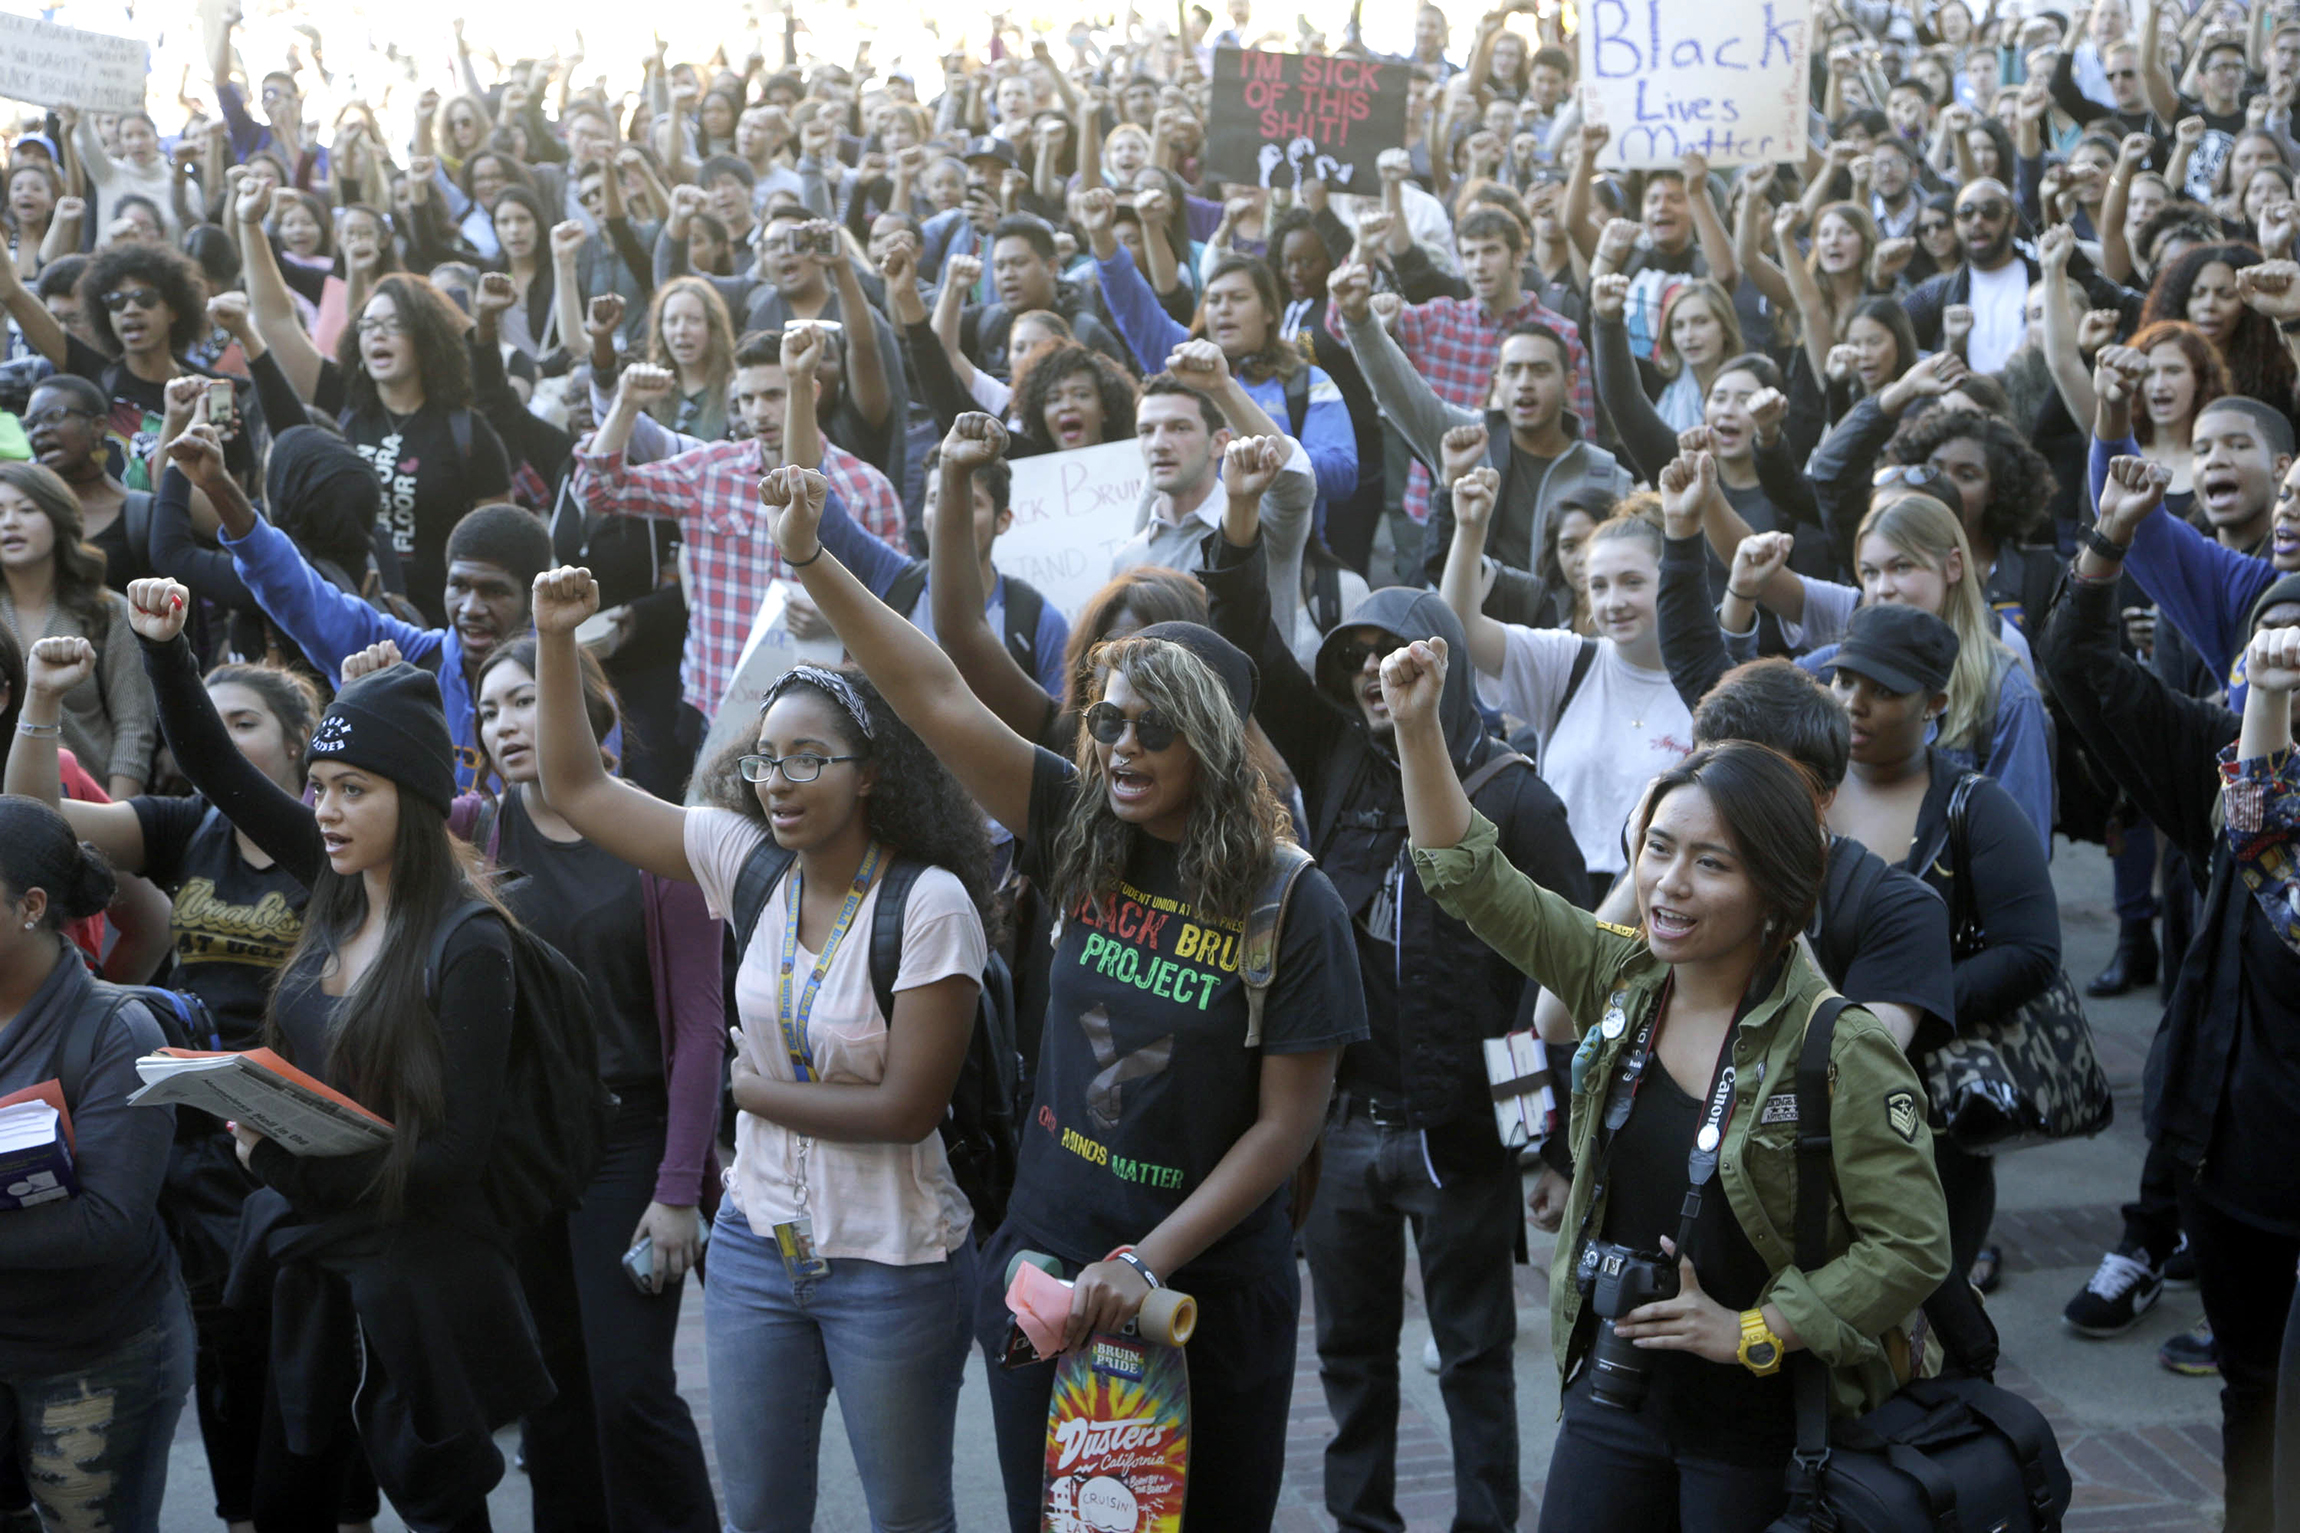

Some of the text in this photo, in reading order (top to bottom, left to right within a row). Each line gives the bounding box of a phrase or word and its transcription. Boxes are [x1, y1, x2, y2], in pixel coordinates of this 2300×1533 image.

[1594, 0, 1805, 78] Black
[1240, 53, 1383, 92] I'M SICK
[1245, 80, 1371, 120] OF THIS
[1636, 79, 1739, 122] Lives
[1260, 110, 1350, 147] SHIT!
[784, 884, 800, 958] UCLA Bruins
[1152, 896, 1178, 914] UNION
[1178, 902, 1191, 917] AT
[820, 894, 860, 965] UCLA Bruins
[1079, 932, 1221, 1011] PROJECT
[800, 986, 817, 1017] UCLA
[1061, 1127, 1108, 1166] MINDS
[1112, 1154, 1185, 1190] MATTER
[1096, 1354, 1139, 1375] PRIDE
[1097, 1342, 1140, 1363] BRUIN
[1101, 1451, 1166, 1478] California
